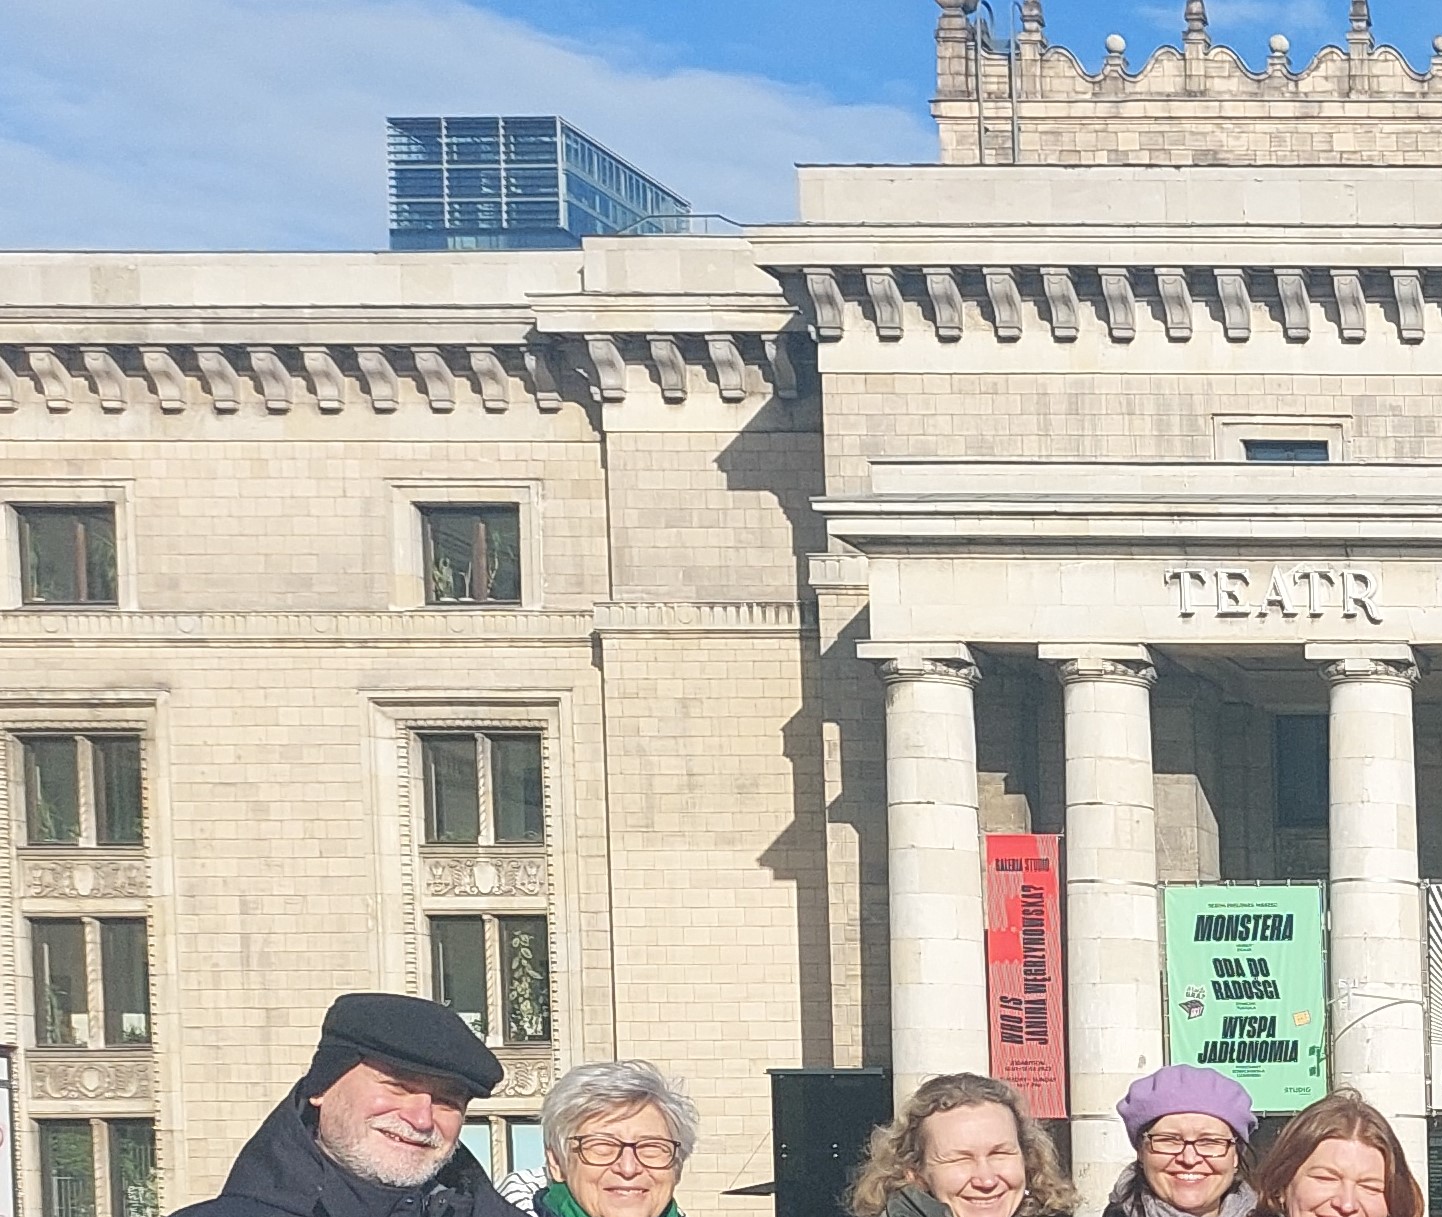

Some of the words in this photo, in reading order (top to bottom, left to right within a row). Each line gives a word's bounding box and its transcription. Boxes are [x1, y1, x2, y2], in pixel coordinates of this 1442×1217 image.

[1163, 568, 1383, 624] TEATR
[995, 857, 1023, 872] GALERIA
[1024, 857, 1050, 872] STUDIO
[1021, 884, 1052, 995] WĘGRZYNOWSKA?
[1193, 913, 1295, 943] MONSTERA
[1212, 958, 1246, 979] ODA
[1246, 957, 1271, 978] DO
[1210, 977, 1282, 1000] RADOŚCI
[999, 995, 1023, 1012] IS
[1000, 1014, 1024, 1045] WHO
[1024, 998, 1049, 1046] JANINA
[1221, 1015, 1277, 1040] WYSPA
[1197, 1039, 1299, 1064] JADŁONOMIA
